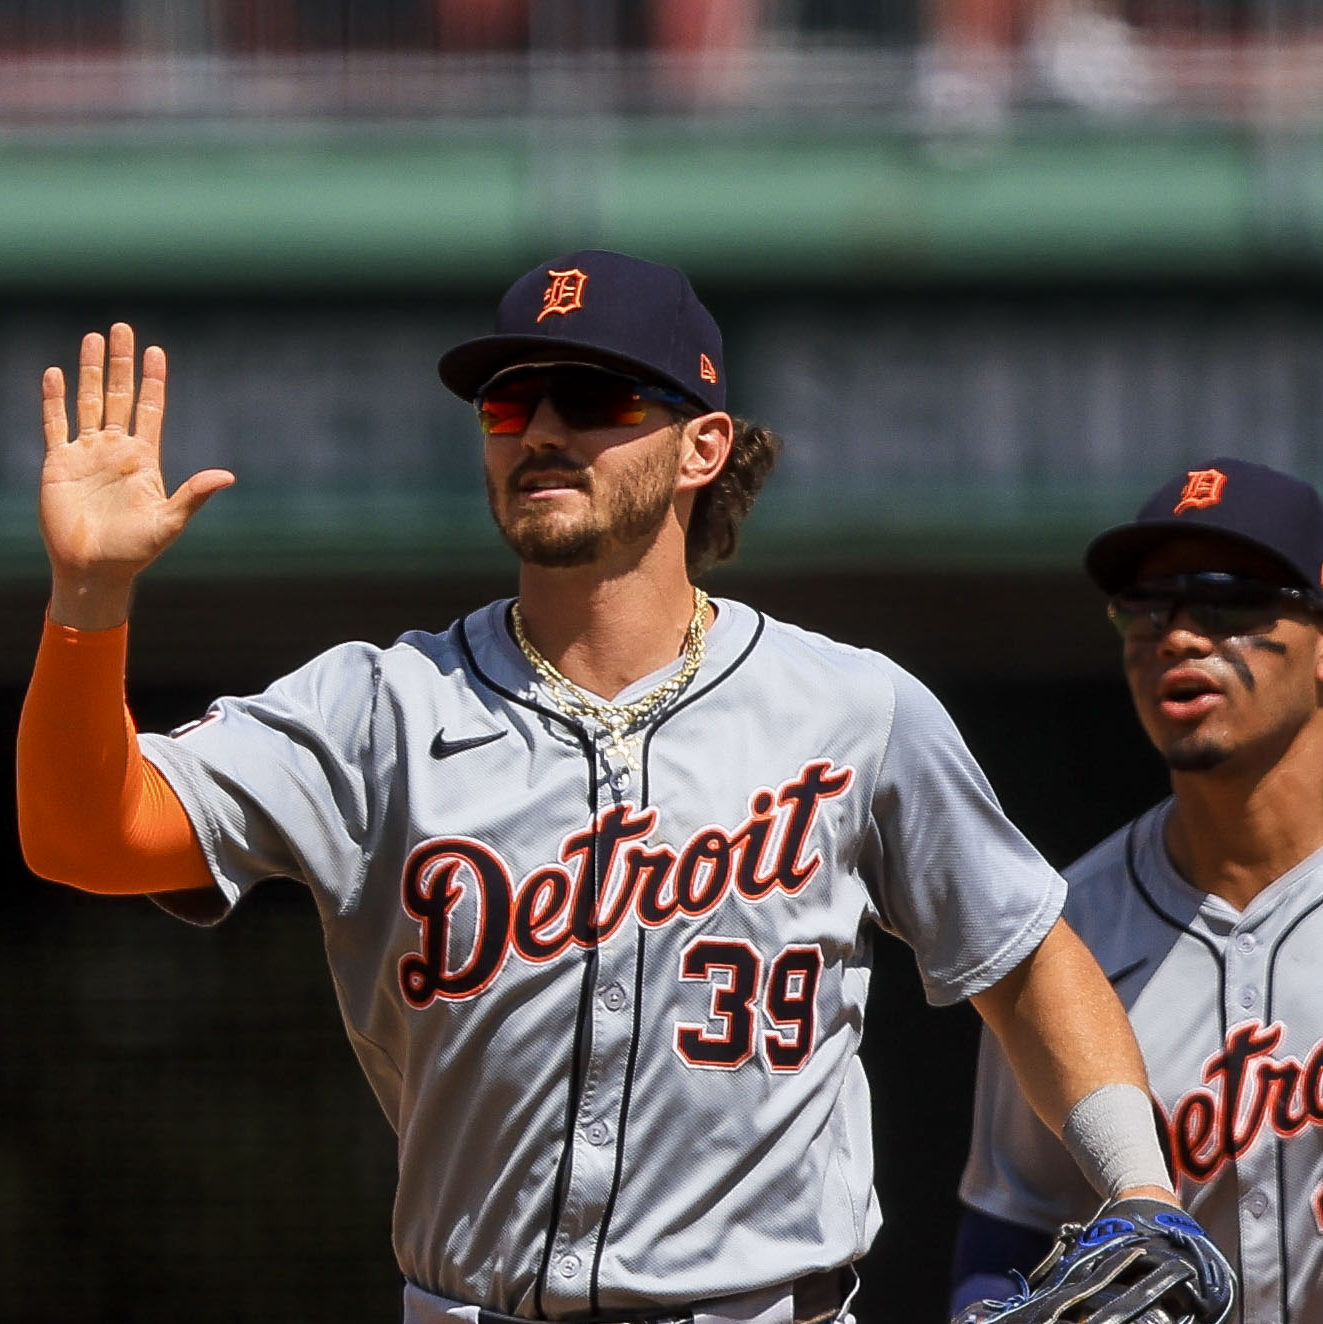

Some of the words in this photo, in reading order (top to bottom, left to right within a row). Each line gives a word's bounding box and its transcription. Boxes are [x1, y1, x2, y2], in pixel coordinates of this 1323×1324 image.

[536, 267, 589, 324] D
[1173, 468, 1228, 516] D
[398, 757, 857, 1012] Detroit
[673, 935, 825, 1073] 39
